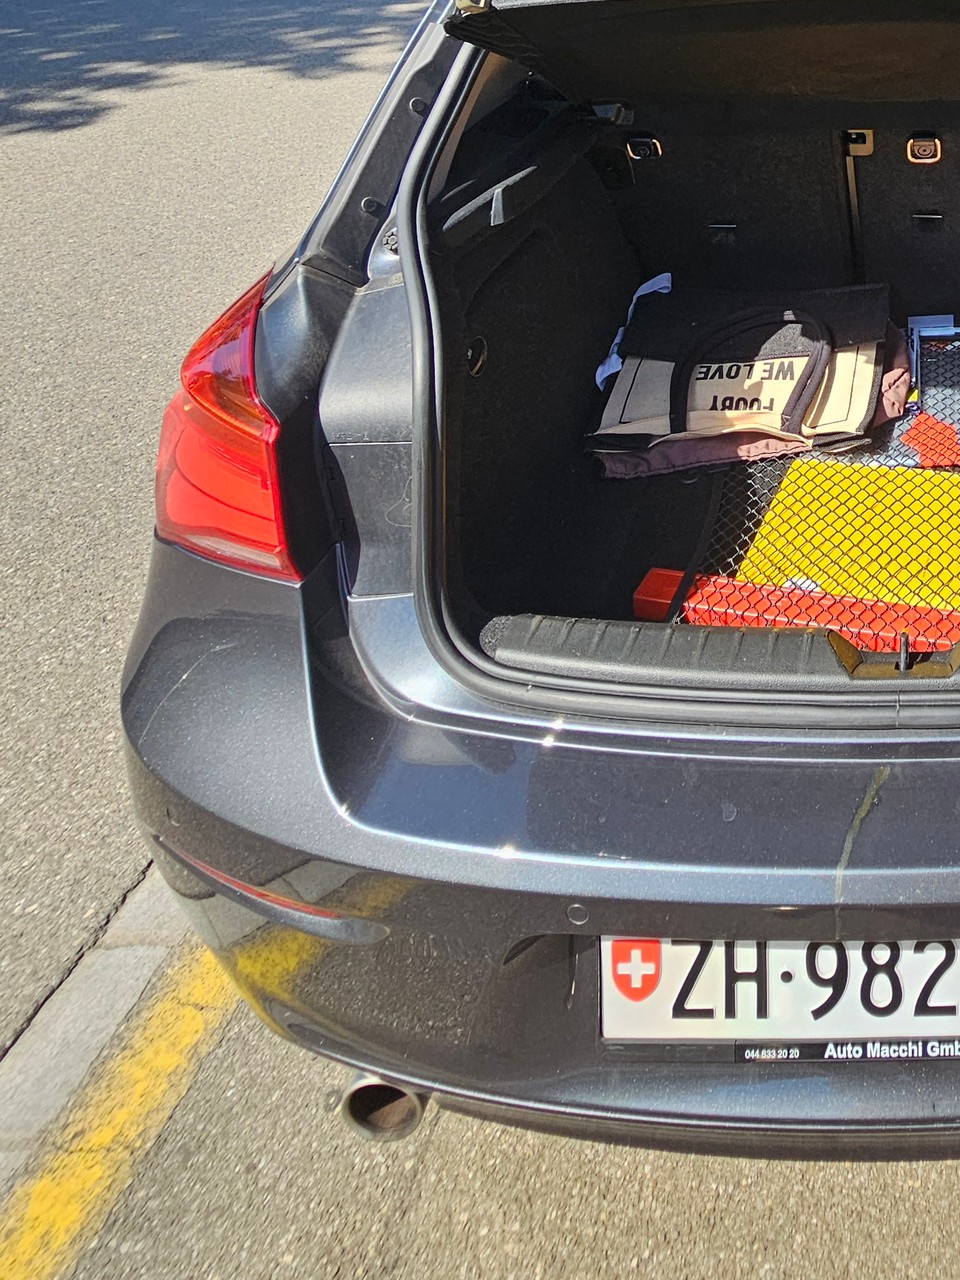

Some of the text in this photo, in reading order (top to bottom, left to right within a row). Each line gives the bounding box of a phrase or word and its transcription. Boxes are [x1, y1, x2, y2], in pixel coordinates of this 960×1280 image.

[696, 361, 795, 380] WE LOVE
[744, 1048, 760, 1060] 044
[824, 1041, 863, 1059] Auto
[866, 1040, 923, 1058] Macchi
